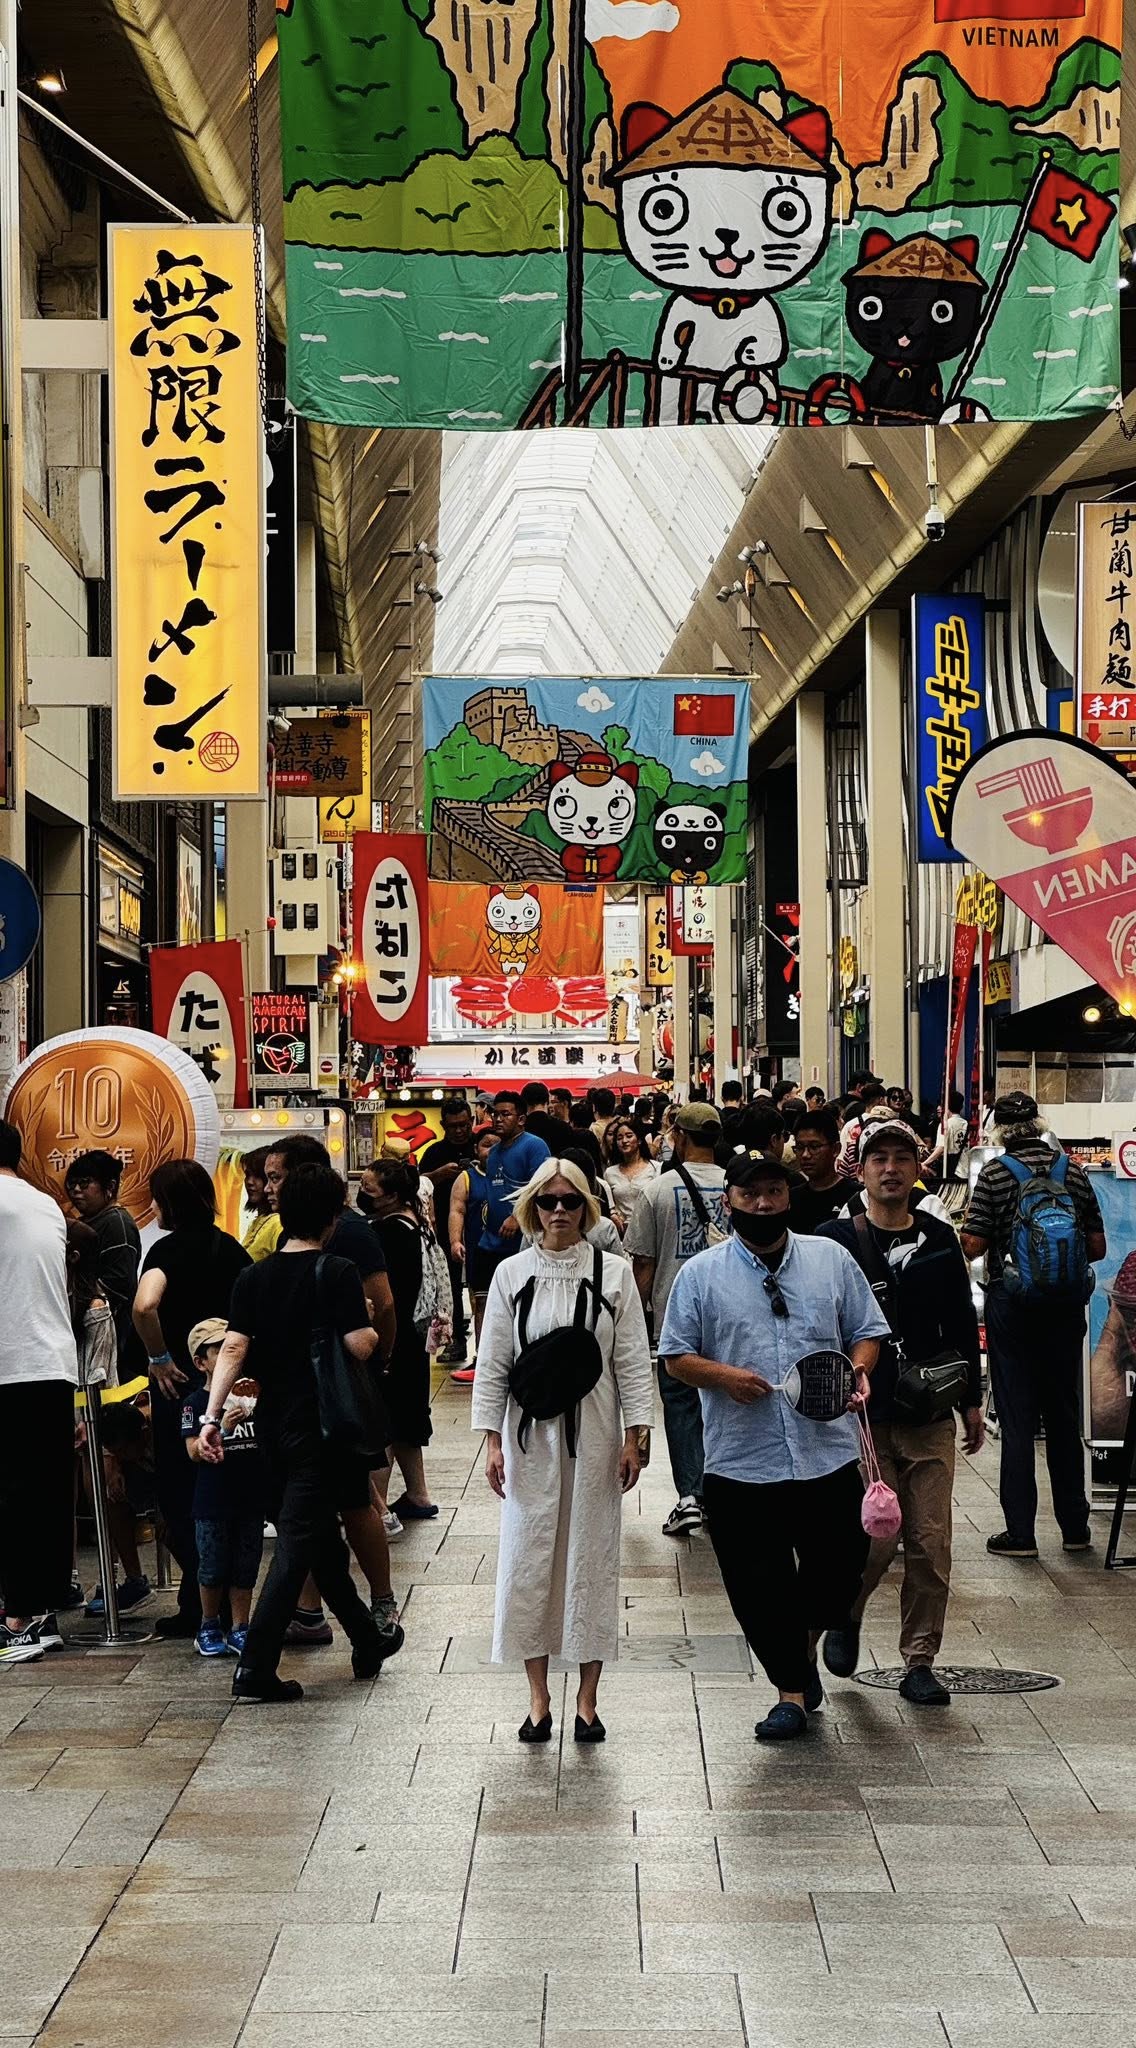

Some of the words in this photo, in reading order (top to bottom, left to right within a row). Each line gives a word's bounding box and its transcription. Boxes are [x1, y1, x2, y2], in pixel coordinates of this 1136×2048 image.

[962, 27, 1059, 48] VIETNAM
[129, 249, 242, 775] 無限ラーメン
[690, 737, 718, 746] CHINA
[253, 995, 306, 1005] NATURAL
[253, 1006, 306, 1016] AMERICAN
[253, 1017, 307, 1033] SPIRIT
[180, 990, 221, 1083] たば
[485, 1047, 584, 1066] かに道楽
[54, 1065, 122, 1140] 10
[46, 1146, 136, 1172] 令和年
[6, 1633, 33, 1647] HOKA
